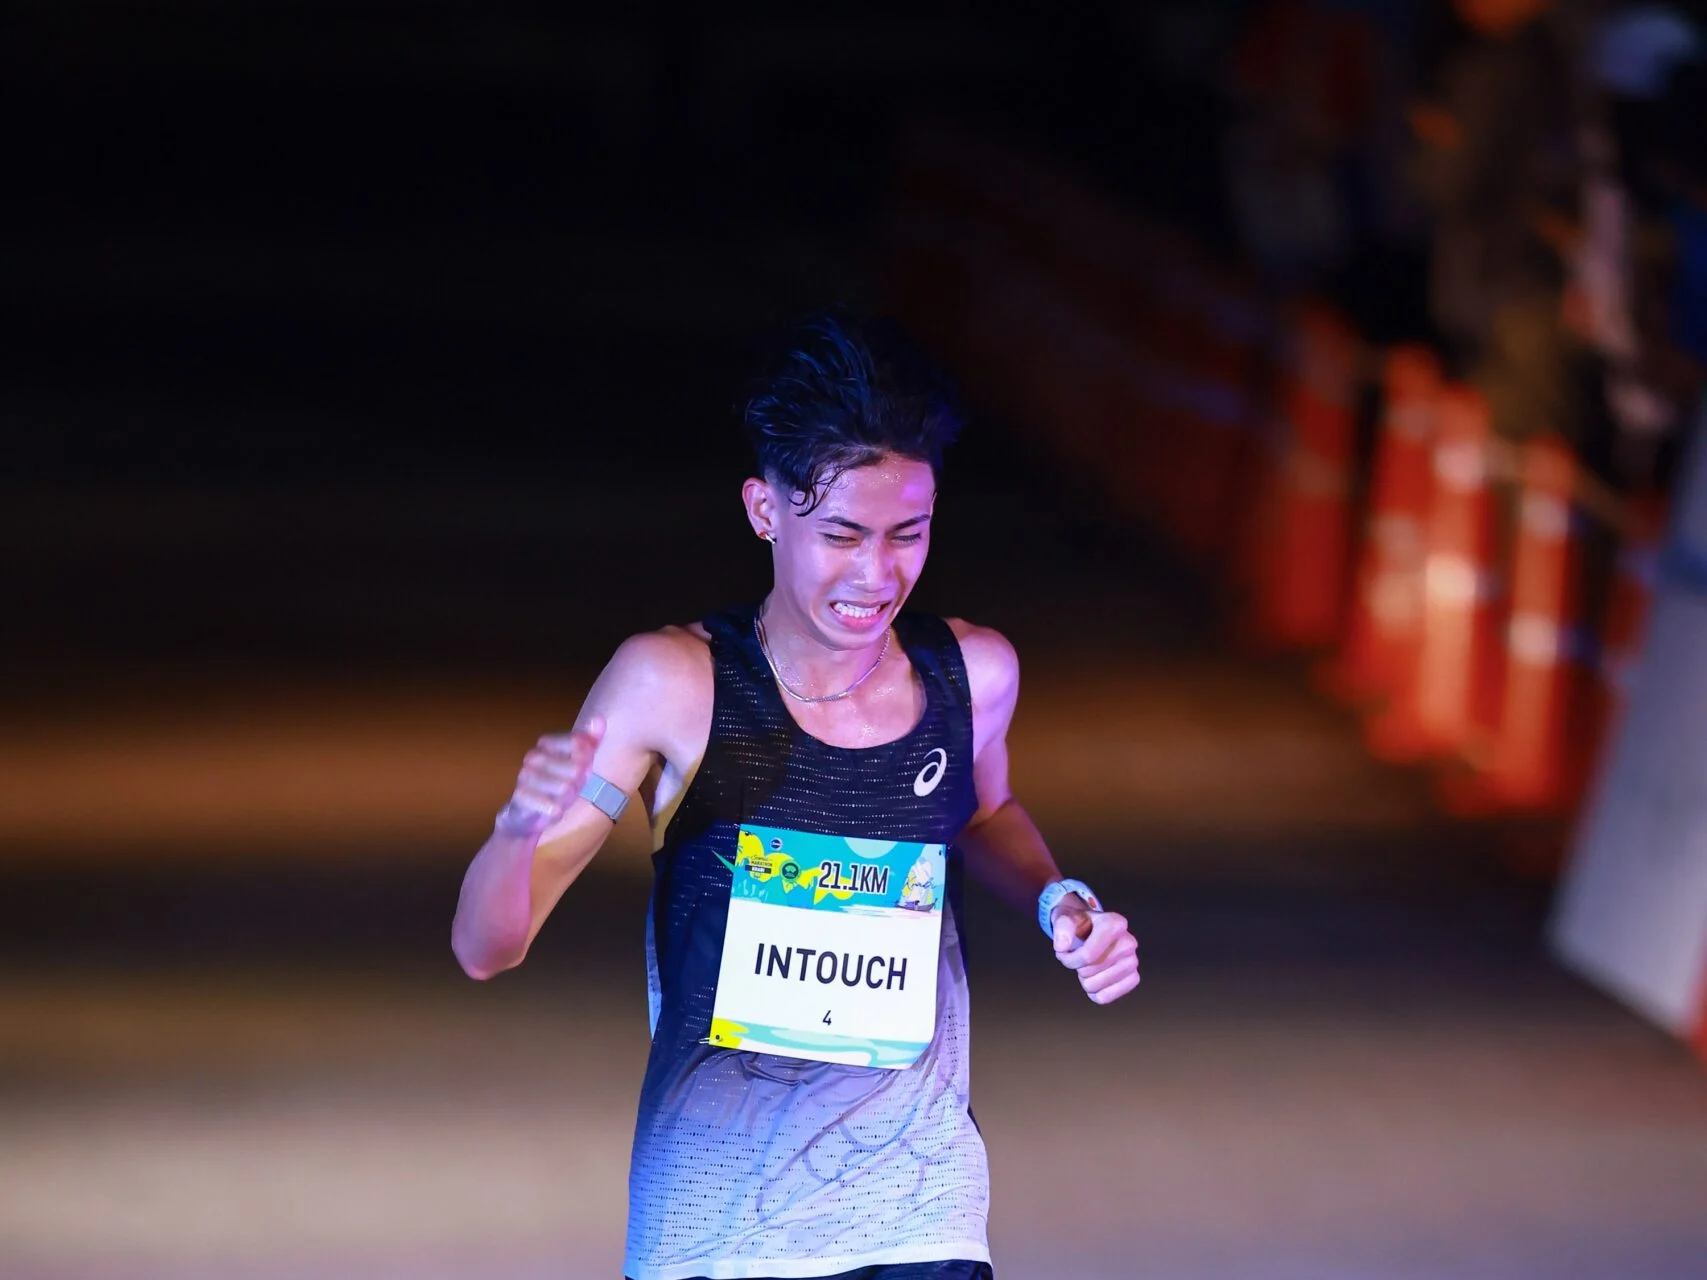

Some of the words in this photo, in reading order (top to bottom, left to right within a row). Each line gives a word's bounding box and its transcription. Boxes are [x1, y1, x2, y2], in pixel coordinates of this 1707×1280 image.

[818, 861, 889, 894] 21.1KM
[754, 943, 908, 991] INTOUCH
[822, 1009, 832, 1026] 4
